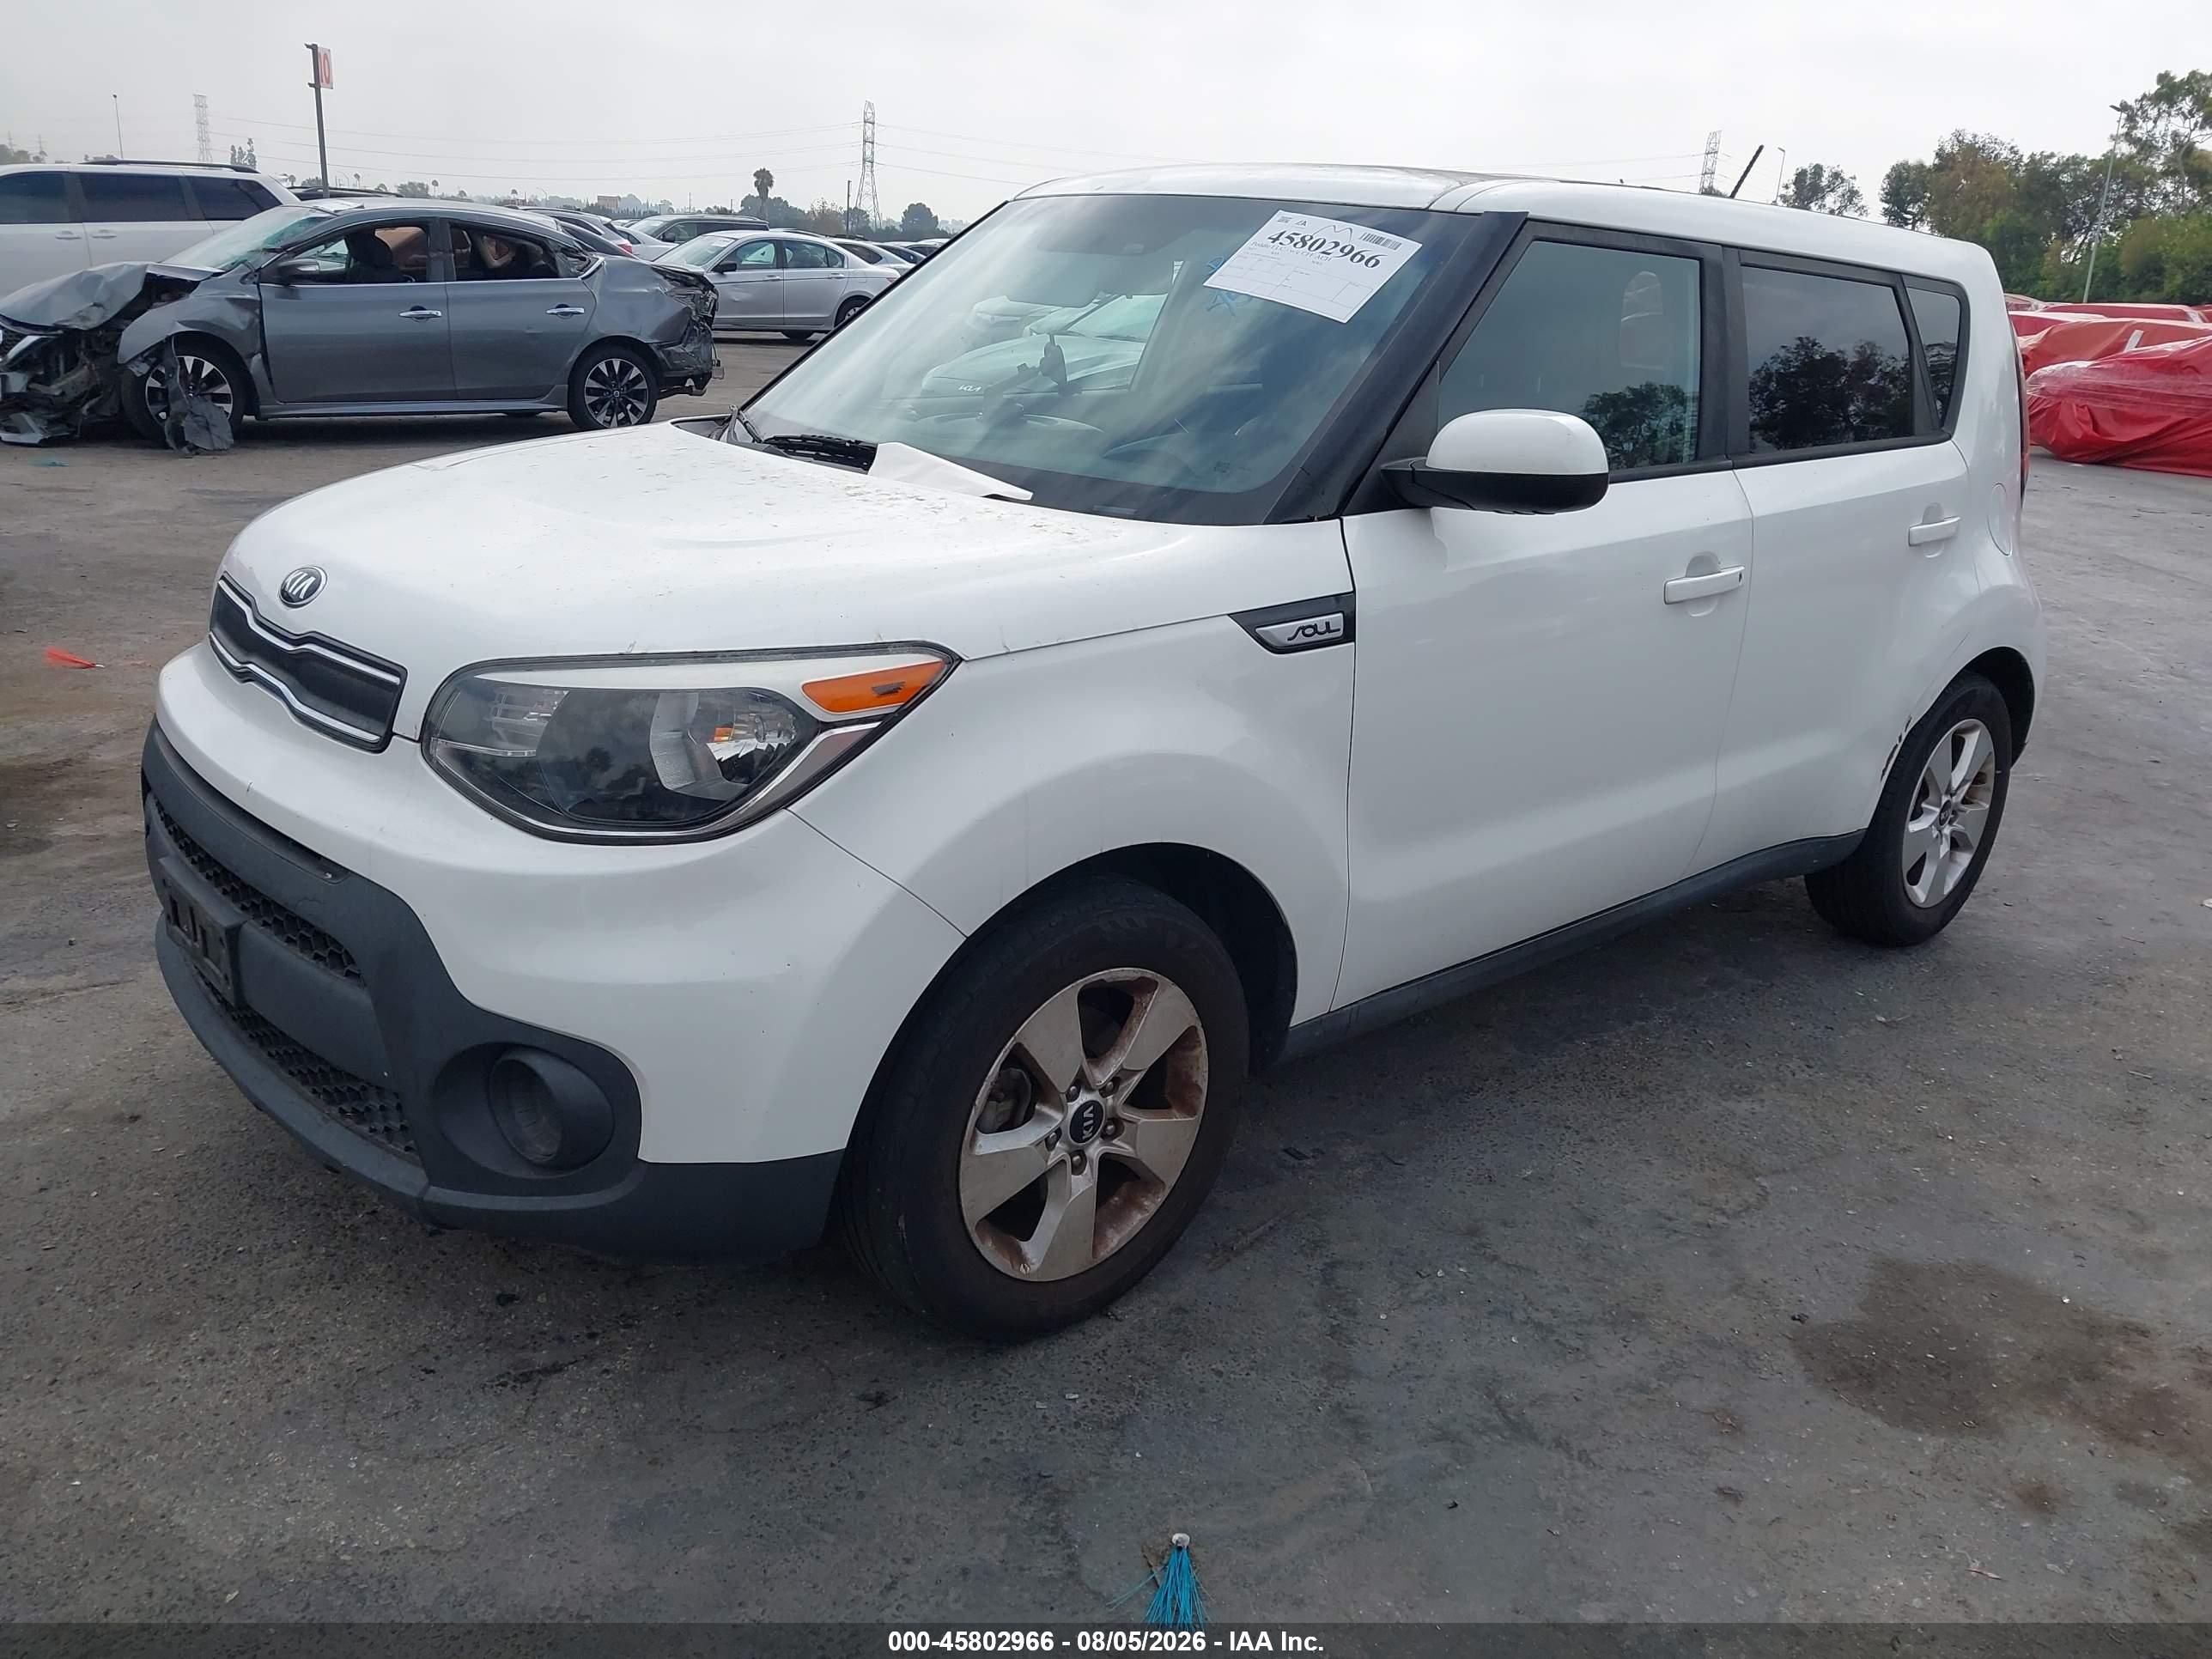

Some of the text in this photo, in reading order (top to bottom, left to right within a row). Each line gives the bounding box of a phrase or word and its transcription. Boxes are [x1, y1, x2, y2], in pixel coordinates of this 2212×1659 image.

[1267, 229, 1389, 269] 45802966
[1286, 621, 1341, 641] SOUL
[1082, 1104, 1095, 1140] KIA
